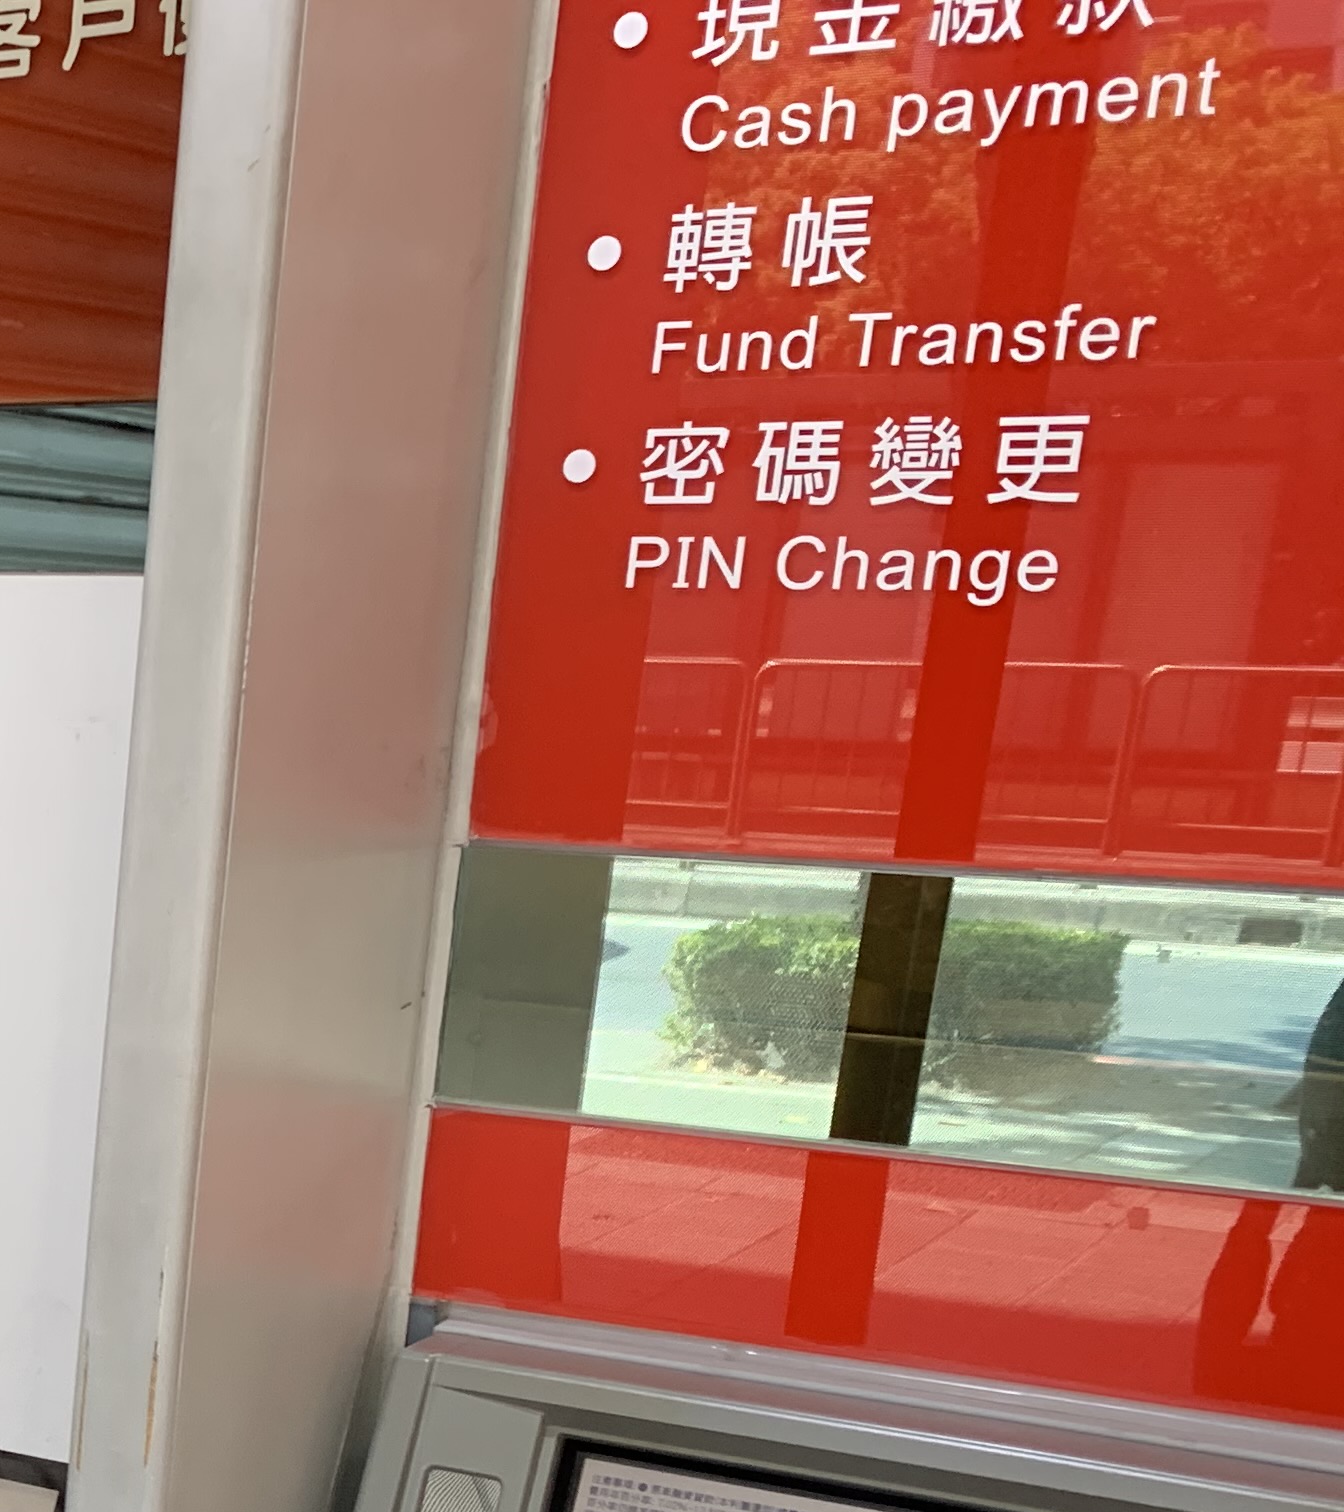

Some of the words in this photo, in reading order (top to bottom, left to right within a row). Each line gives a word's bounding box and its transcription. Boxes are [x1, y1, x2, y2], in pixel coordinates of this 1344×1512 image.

[681, 86, 856, 152] Cash
[888, 59, 1221, 152] payment
[662, 196, 873, 294] 轉帳
[651, 316, 818, 374] Fund
[850, 303, 1155, 367] Transfer
[639, 415, 1090, 507] 密碼變更
[624, 535, 746, 589] PIN
[775, 535, 1059, 606] Change
